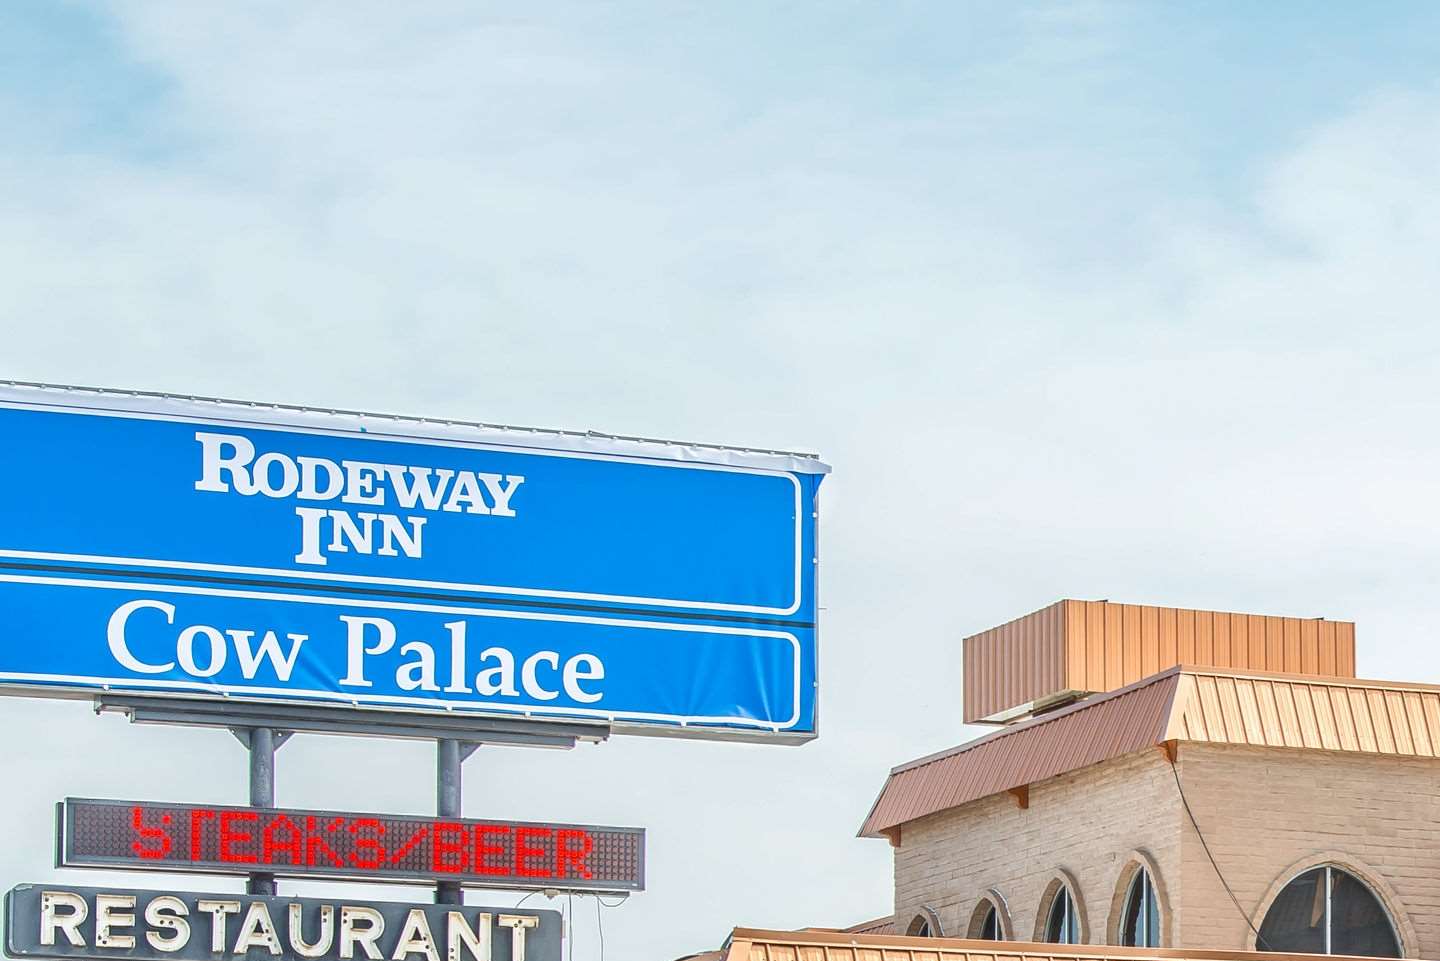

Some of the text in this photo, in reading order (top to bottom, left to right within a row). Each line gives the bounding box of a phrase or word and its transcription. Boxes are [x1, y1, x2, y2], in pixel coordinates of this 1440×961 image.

[195, 431, 525, 518] RODEWAY
[294, 506, 428, 566] INN
[339, 614, 605, 704] Palace
